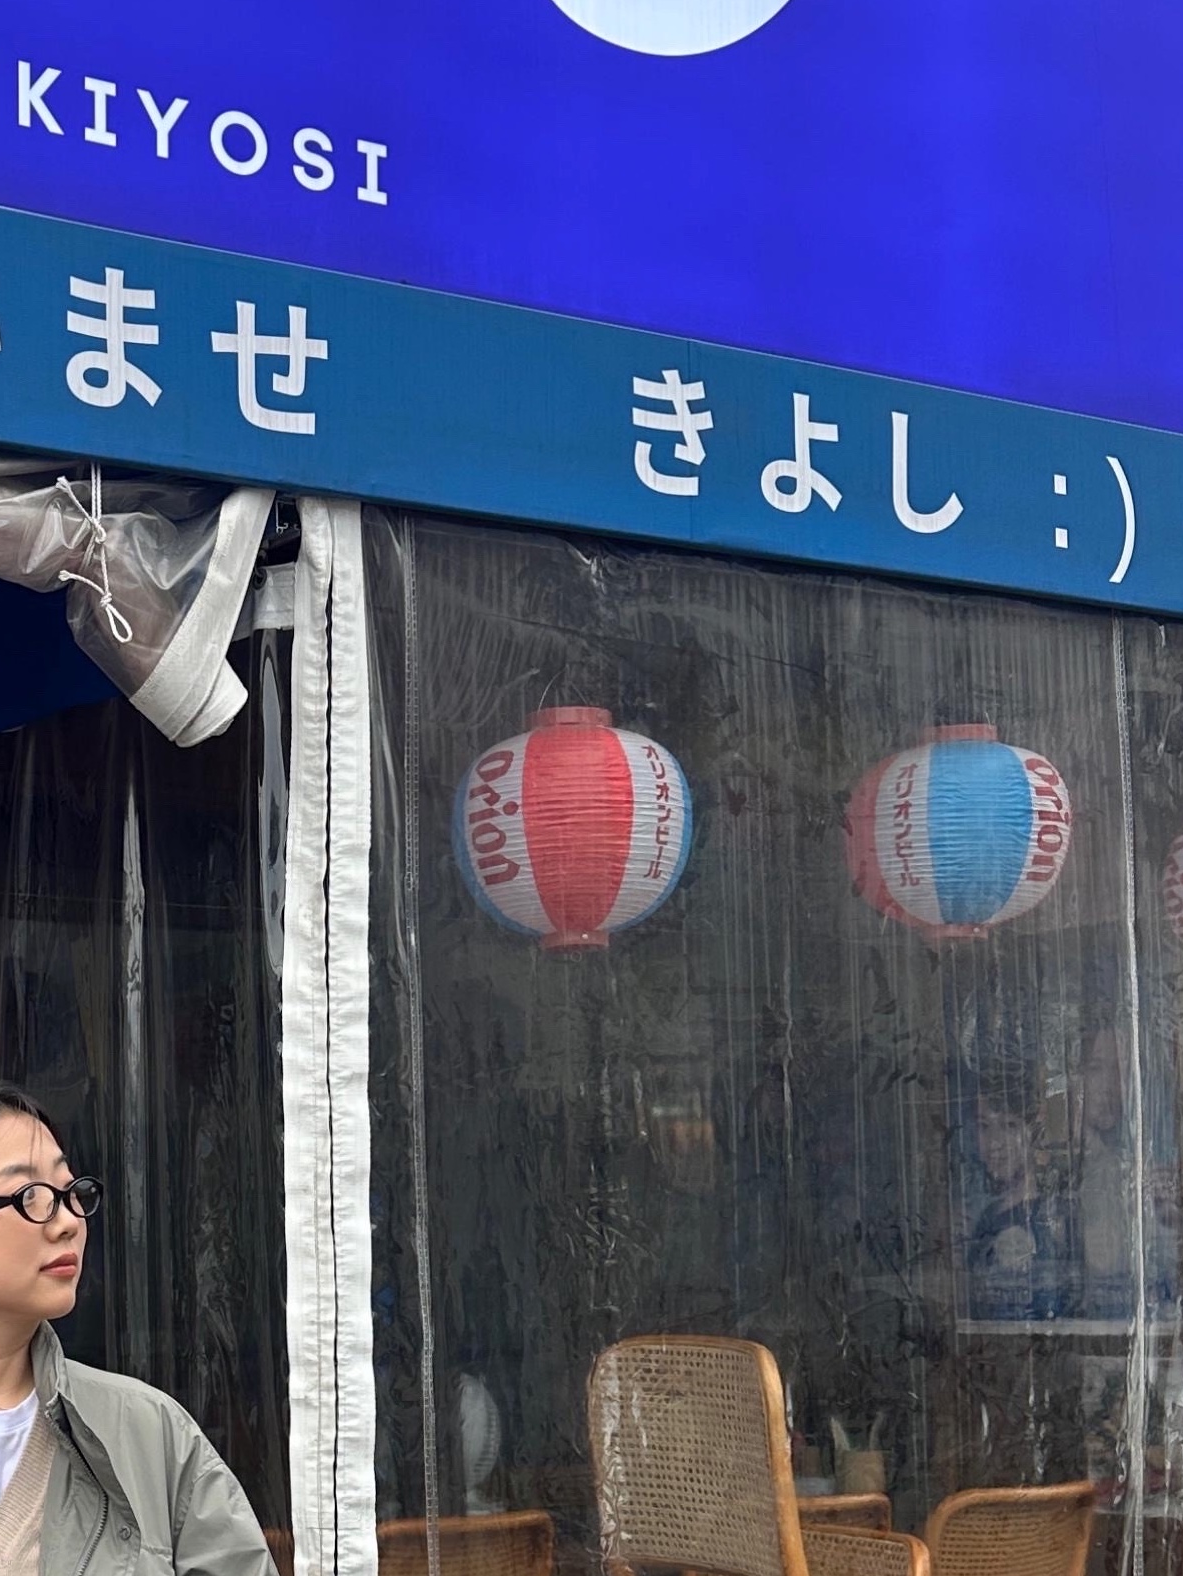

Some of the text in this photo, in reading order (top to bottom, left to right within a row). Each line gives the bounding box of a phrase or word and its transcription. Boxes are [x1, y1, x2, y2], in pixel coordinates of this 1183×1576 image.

[17, 60, 390, 205] KIYOSI
[632, 368, 964, 534] きよし
[642, 745, 670, 879] オリオンビール
[893, 763, 920, 887] オリオンビール
